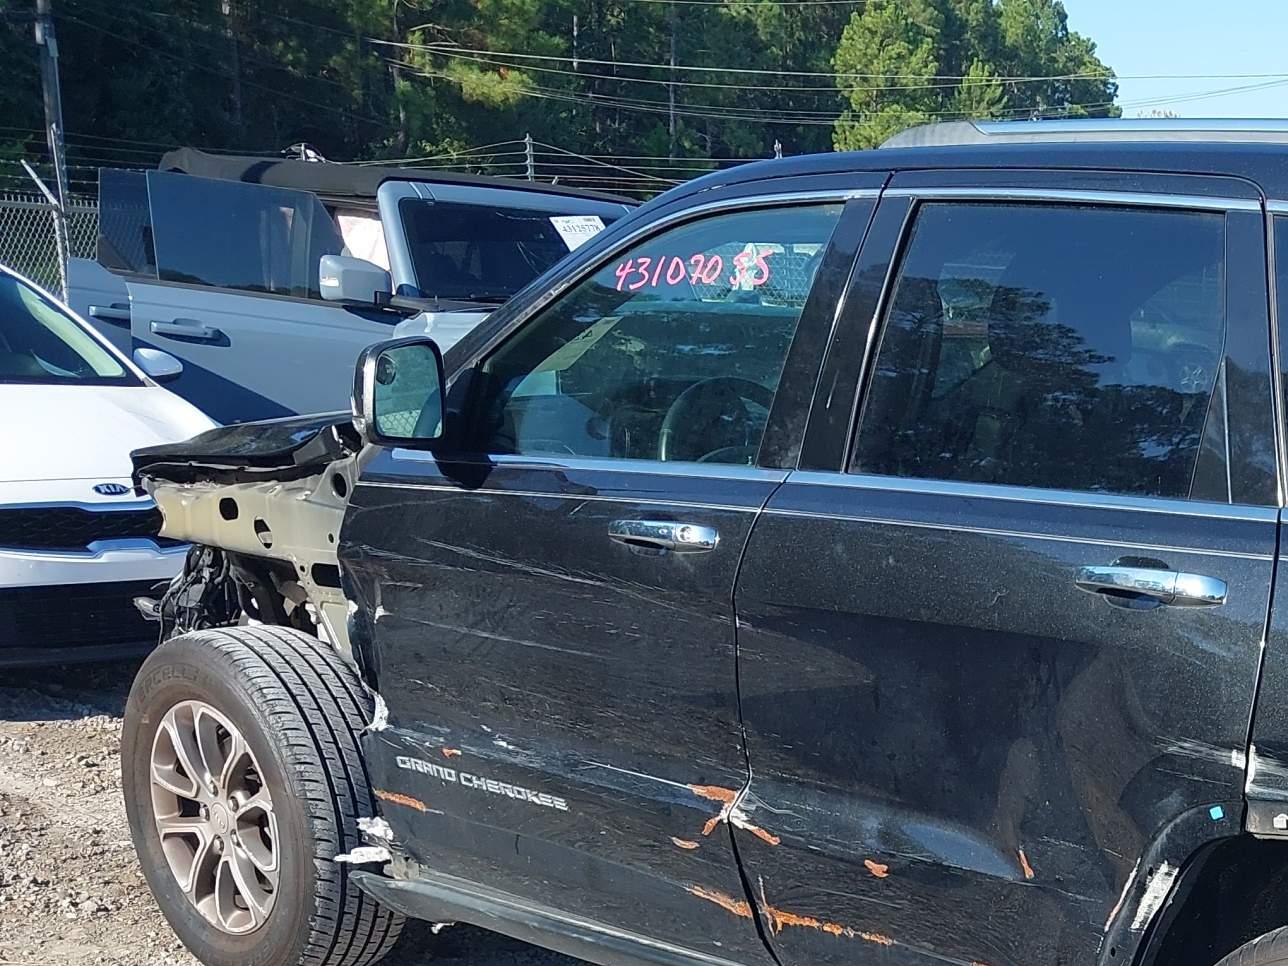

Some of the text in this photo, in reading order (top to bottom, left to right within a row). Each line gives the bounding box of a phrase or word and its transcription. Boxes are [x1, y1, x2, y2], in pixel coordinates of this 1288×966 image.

[96, 483, 129, 495] KIA
[395, 755, 569, 812] GRAND CHEROKEE
